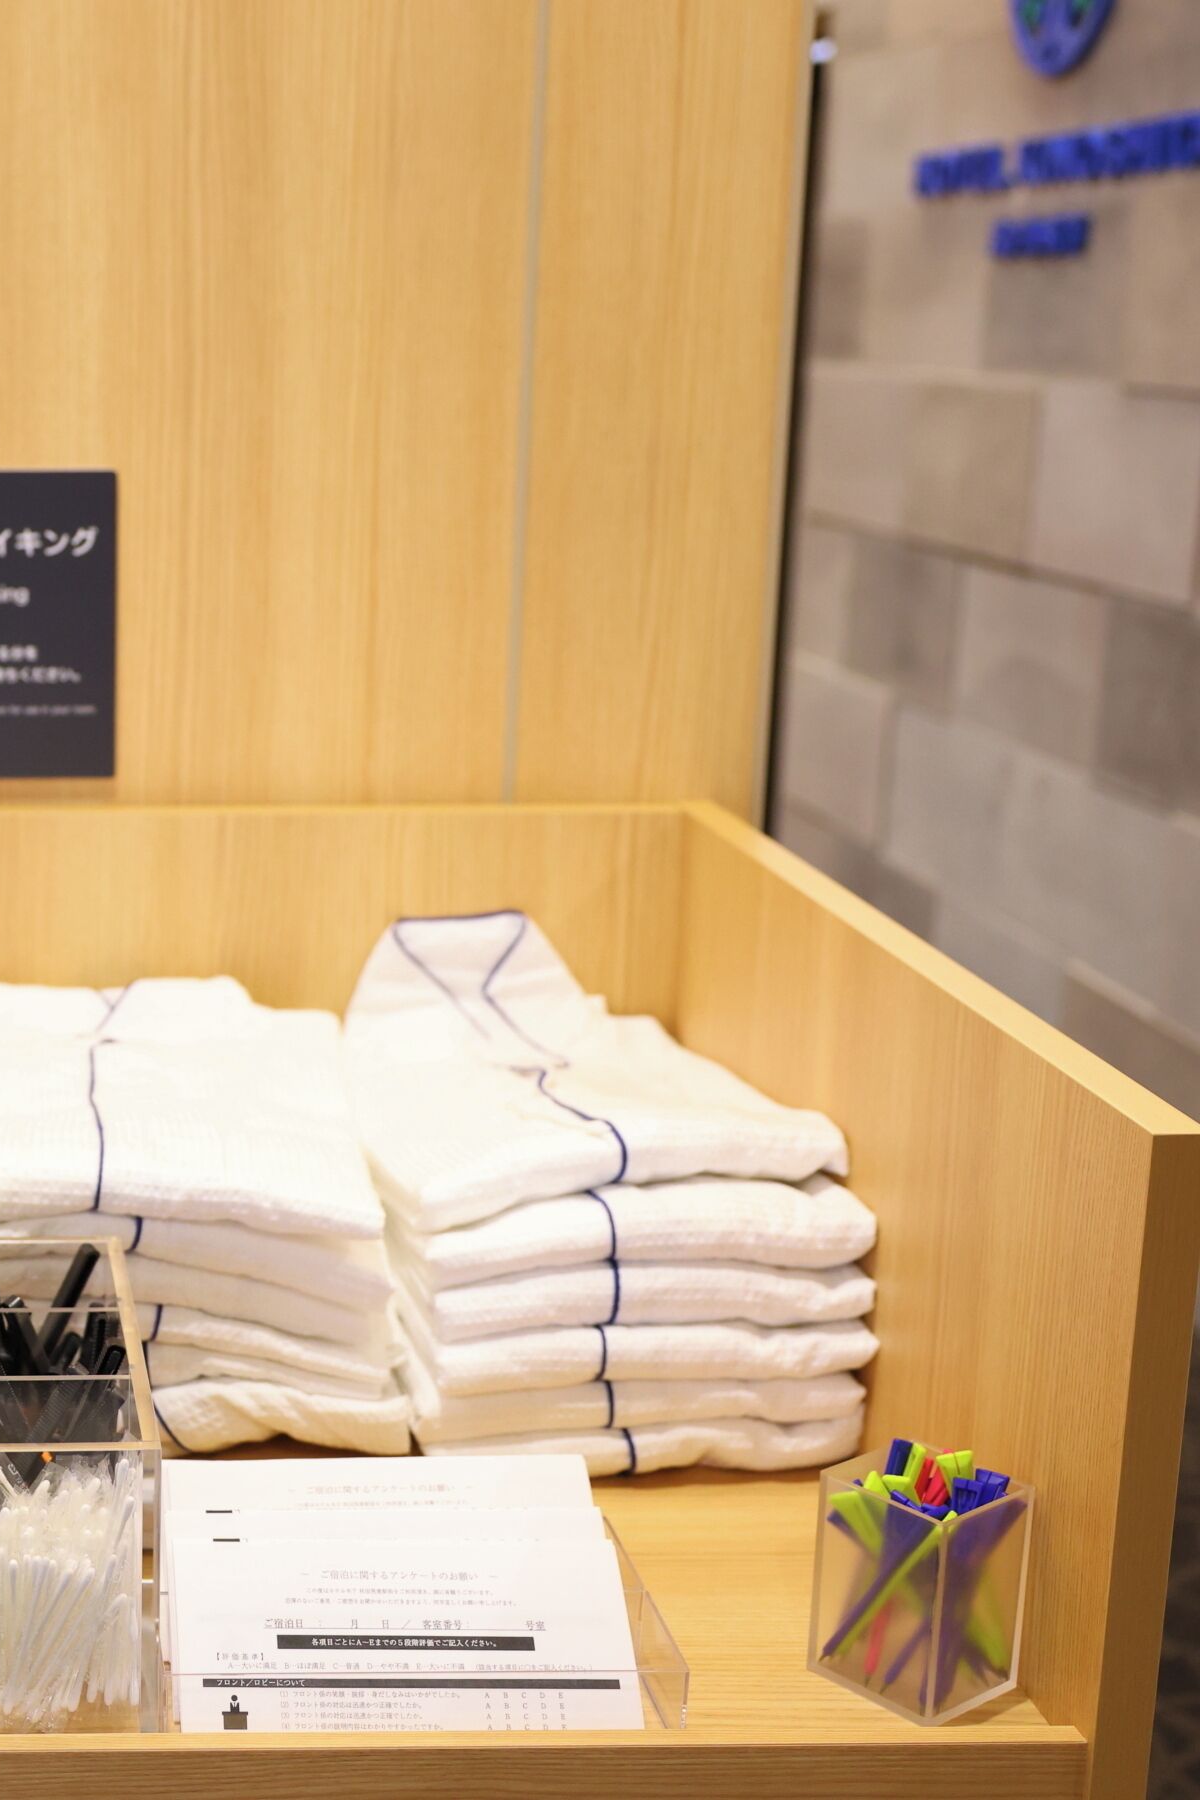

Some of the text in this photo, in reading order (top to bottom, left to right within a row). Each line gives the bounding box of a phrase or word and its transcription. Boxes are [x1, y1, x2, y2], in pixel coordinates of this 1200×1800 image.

[321, 1569, 479, 1581] ご宿泊に関するアンケートのお願い
[264, 1618, 303, 1629] ご宿泊日
[351, 1619, 359, 1629] 月
[382, 1620, 390, 1629] 日
[422, 1619, 462, 1630] 客室番号
